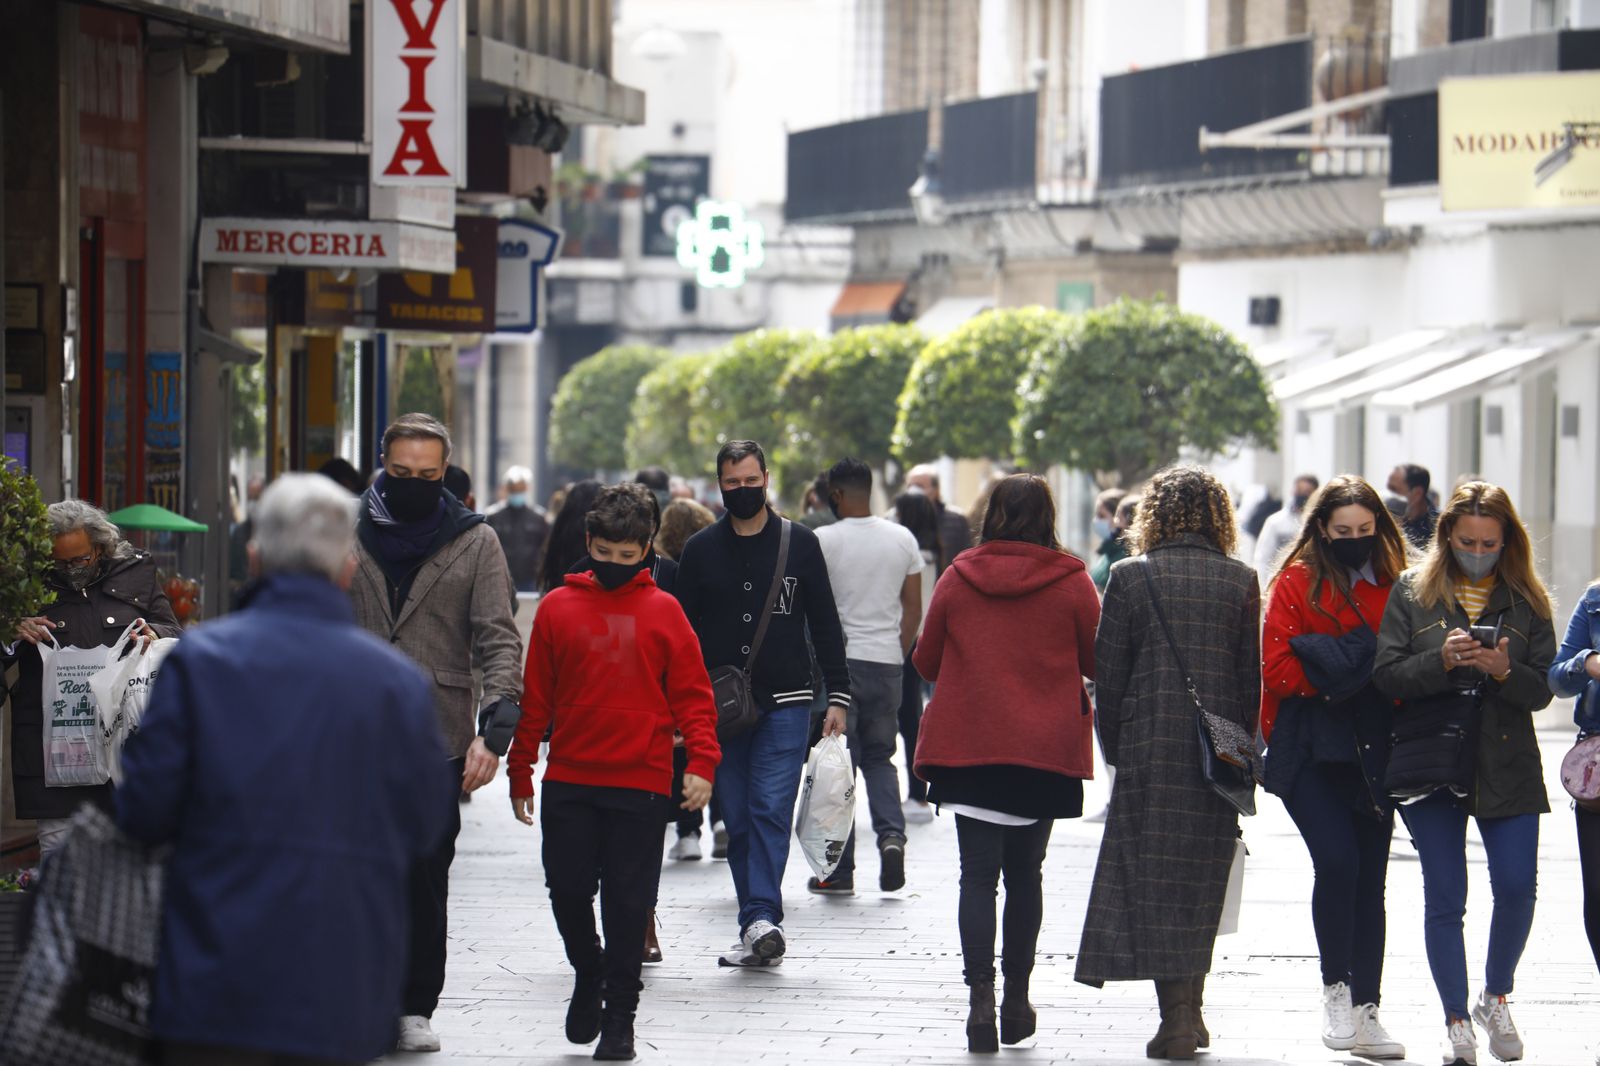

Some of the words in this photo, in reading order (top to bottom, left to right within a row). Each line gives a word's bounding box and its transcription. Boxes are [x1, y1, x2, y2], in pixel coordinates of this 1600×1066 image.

[382, 0, 452, 176] VIA
[216, 229, 387, 258] MERCERIA
[389, 303, 484, 322] TABACOS
